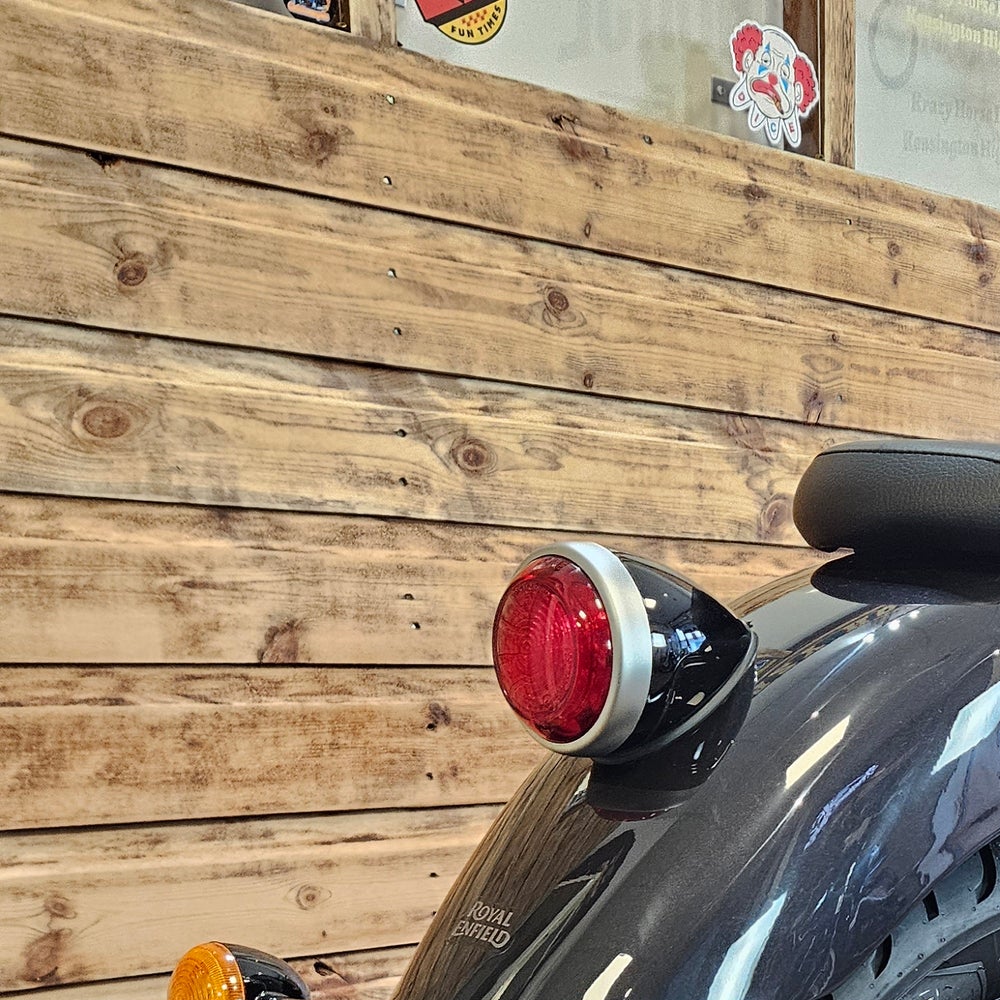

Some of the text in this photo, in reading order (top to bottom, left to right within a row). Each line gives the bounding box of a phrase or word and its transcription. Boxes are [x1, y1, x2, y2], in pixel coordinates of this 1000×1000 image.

[451, 4, 502, 38] FUN TIMES
[905, 5, 982, 43] Kensington
[466, 901, 514, 927] ROYAL
[450, 920, 511, 949] ENFIELD
